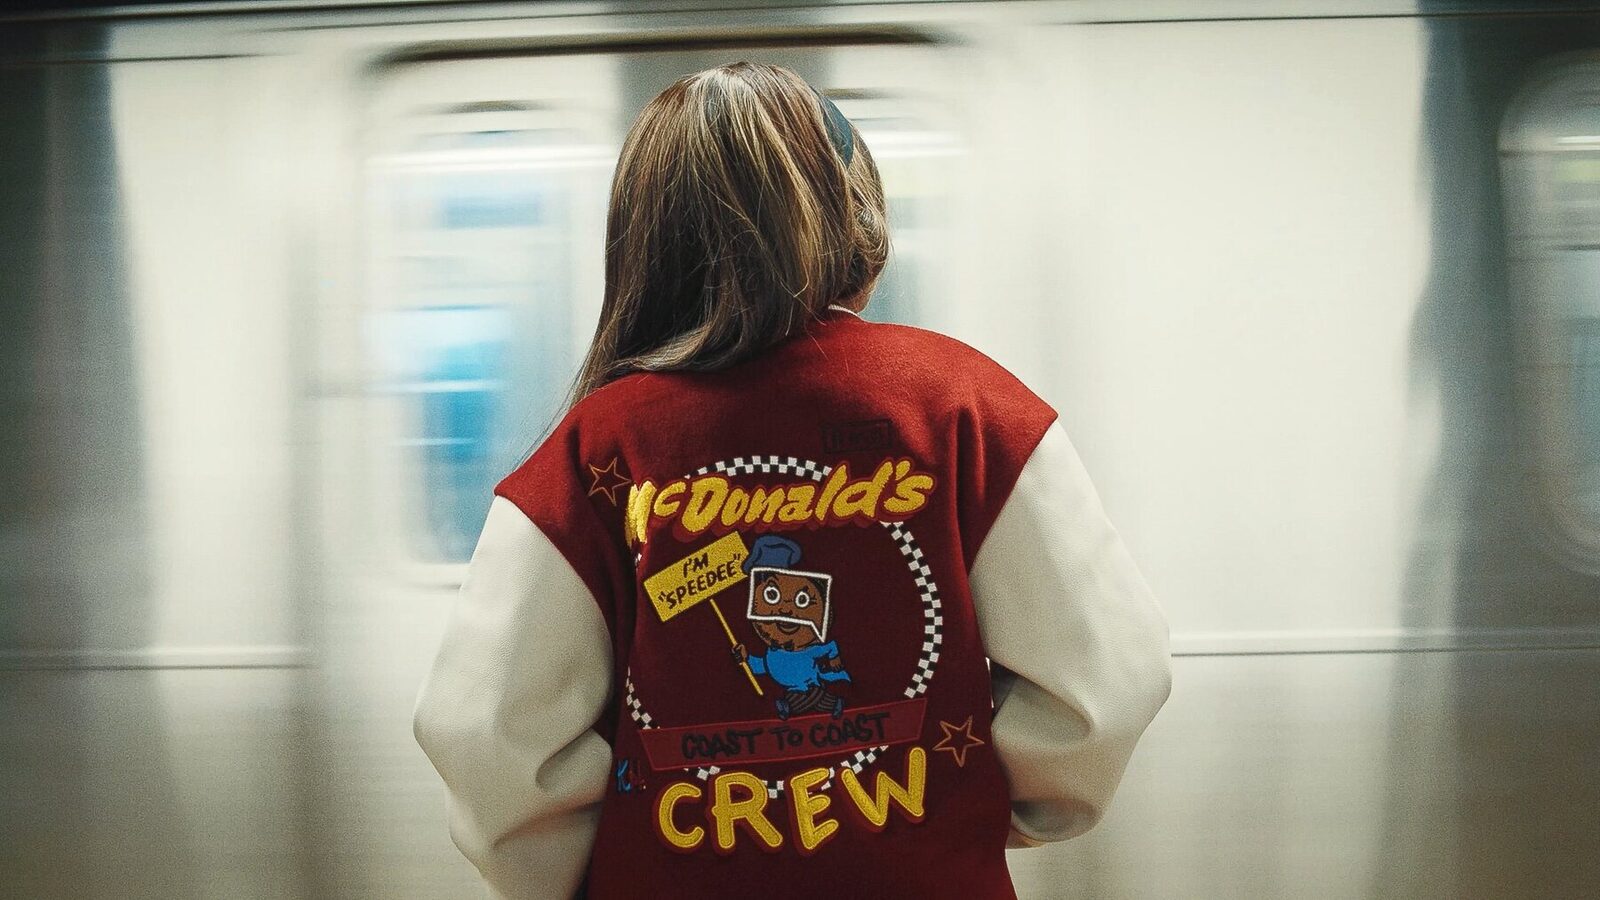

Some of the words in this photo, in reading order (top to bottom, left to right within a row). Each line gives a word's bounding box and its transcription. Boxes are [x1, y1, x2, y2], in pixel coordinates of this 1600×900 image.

[625, 460, 935, 547] McDonald's
[658, 553, 741, 610] "SPEEDEE"
[682, 552, 709, 578] I'M
[681, 728, 763, 760] COAST
[808, 712, 890, 747] COAST
[658, 746, 927, 850] CREW
